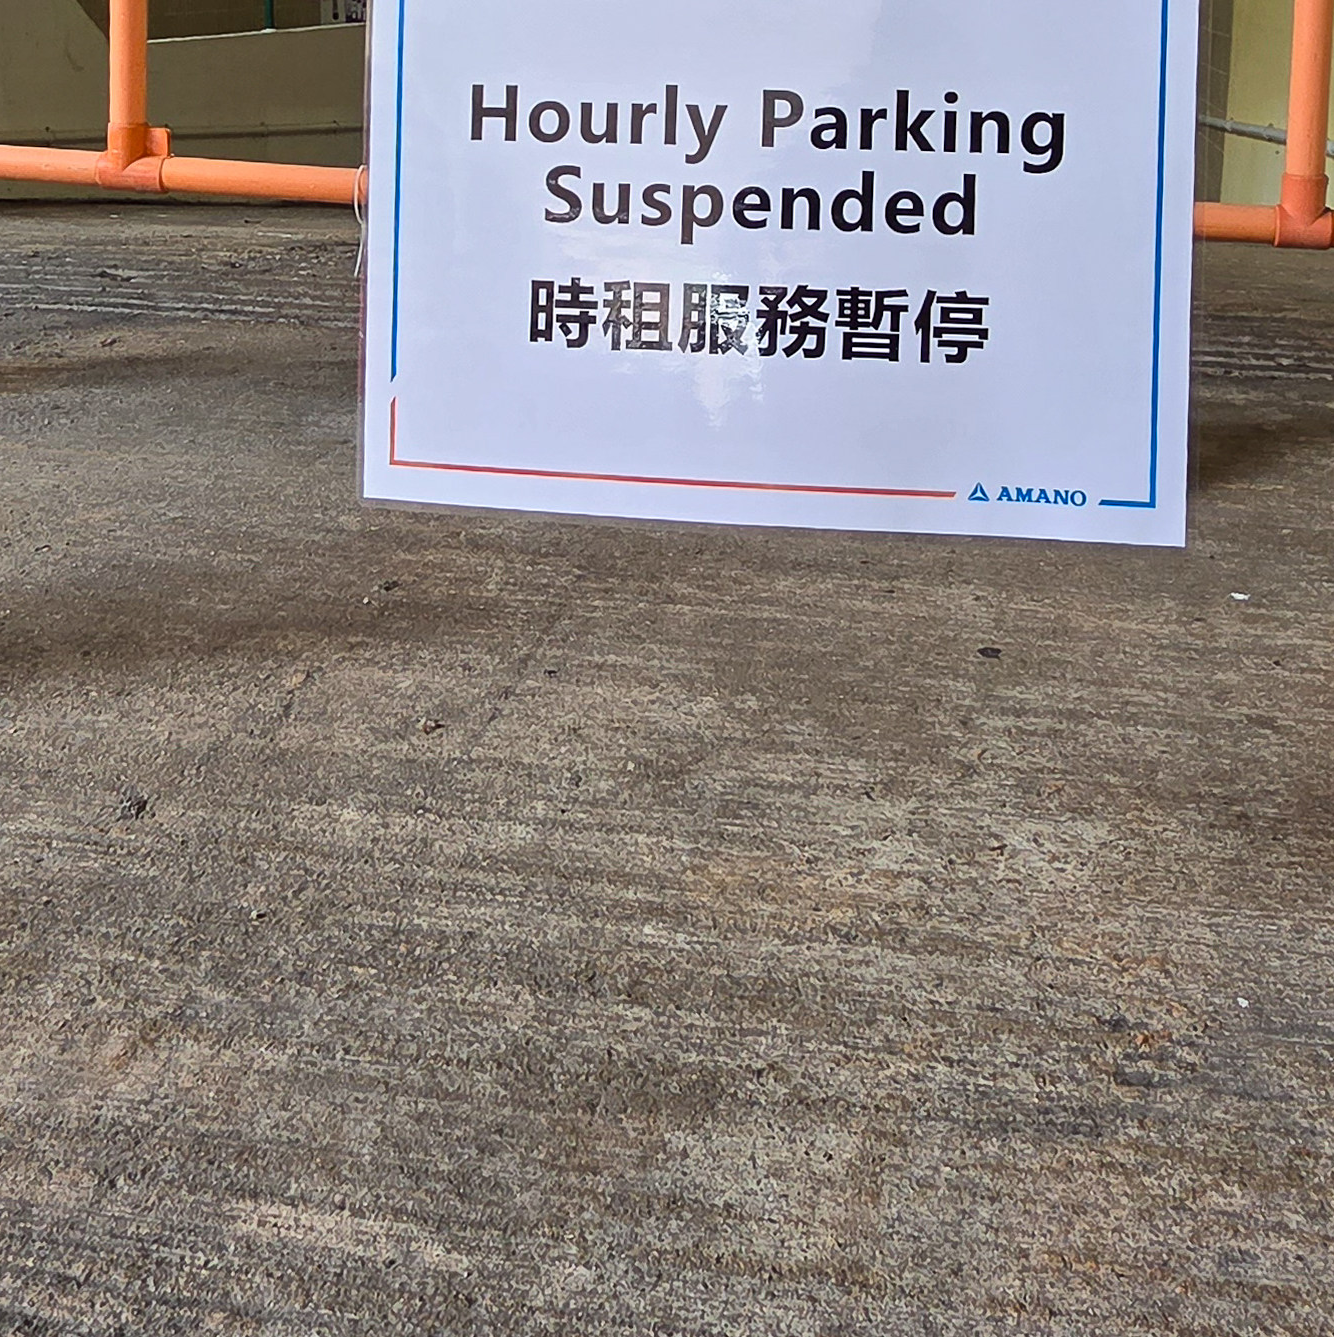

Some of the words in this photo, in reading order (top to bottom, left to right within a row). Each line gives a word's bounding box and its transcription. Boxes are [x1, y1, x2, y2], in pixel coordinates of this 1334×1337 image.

[470, 84, 728, 165] Hourly
[762, 89, 1065, 174] Parking
[544, 165, 977, 245] Suspended
[529, 277, 990, 364] 時租服務暫停
[996, 486, 1087, 506] AMANO
